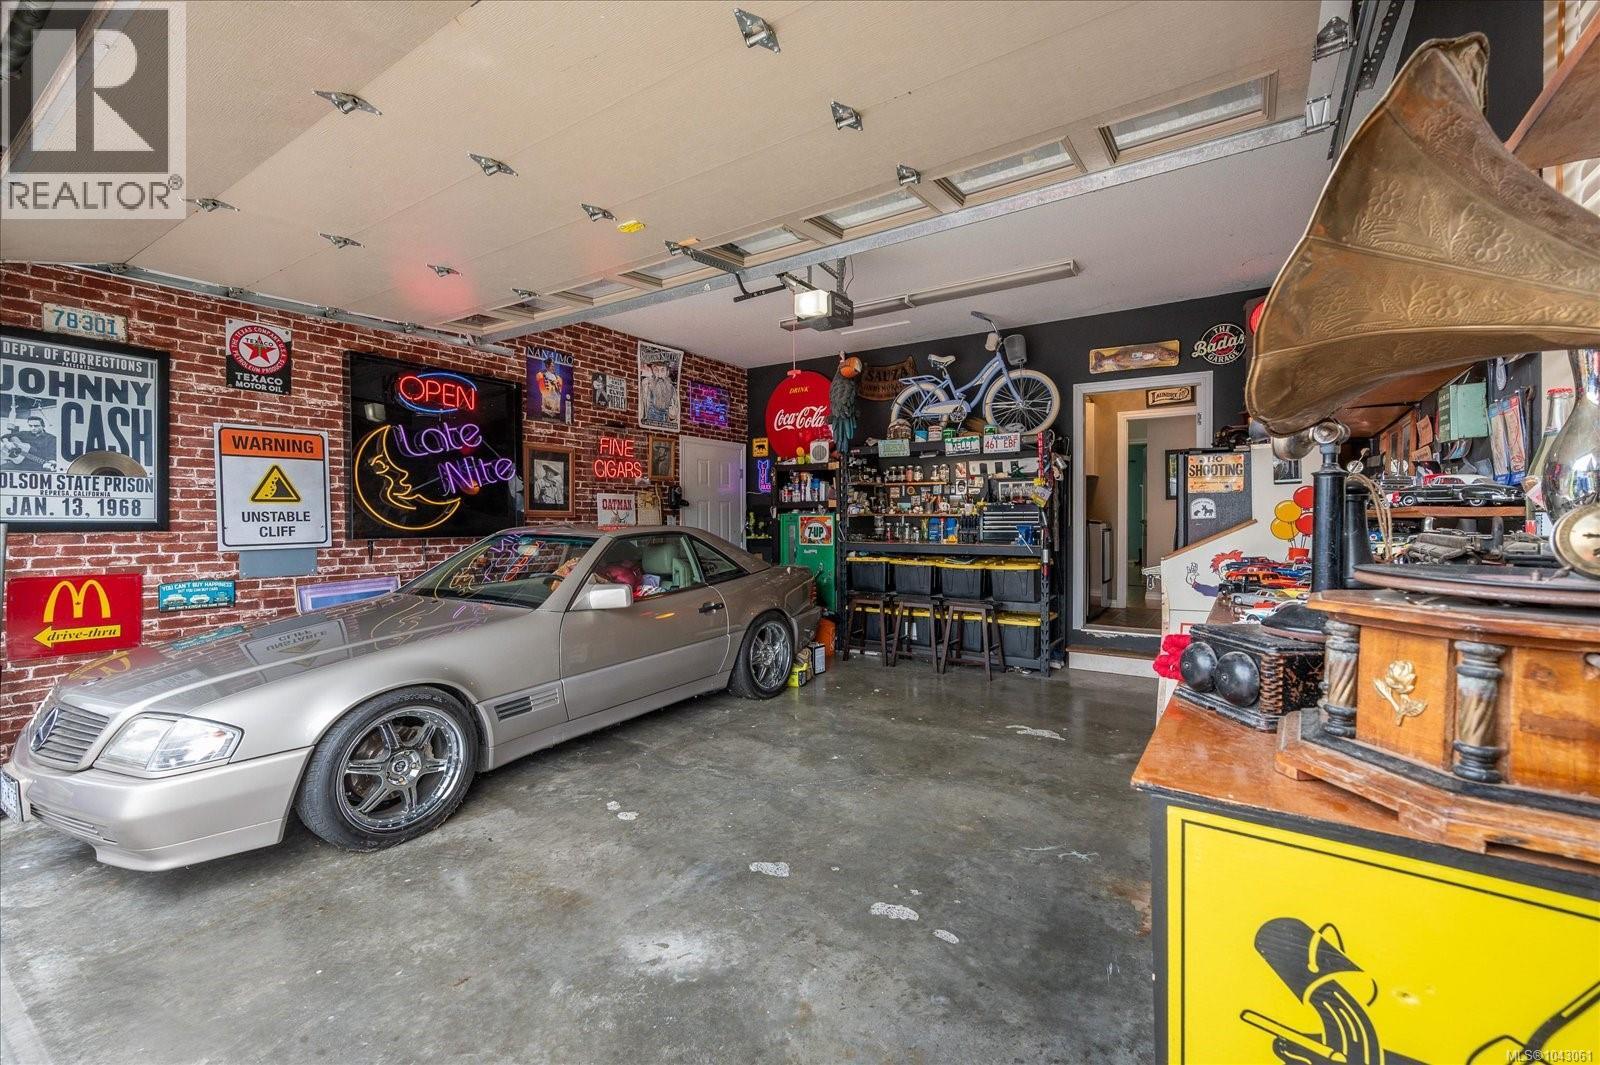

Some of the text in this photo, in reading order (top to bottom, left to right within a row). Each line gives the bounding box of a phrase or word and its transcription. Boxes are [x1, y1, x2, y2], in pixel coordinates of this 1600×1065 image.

[53, 309, 119, 336] 78301
[1213, 326, 1231, 334] THE
[254, 327, 278, 341] COMPANY
[244, 338, 274, 347] TEXACO
[2, 341, 143, 373] DEPT. OF CORRECTIONS
[231, 350, 261, 373] PETROLEUM
[527, 346, 574, 365] NANAIMO
[1207, 350, 1240, 363] GARAGE
[0, 363, 152, 406] JOHNNY
[235, 372, 283, 386] TEXACO
[235, 380, 283, 393] MOTOR OIL
[399, 375, 475, 411] OPEN
[789, 386, 809, 395] DRINK
[774, 405, 828, 431] Coca-Cola
[61, 401, 153, 467] CASH
[398, 422, 483, 457] Late
[232, 435, 314, 454] WARNING
[600, 437, 635, 457] FINE
[985, 438, 1019, 450] 461 EBF
[594, 459, 643, 478] CIGARS
[1189, 463, 1243, 477] SHOOTING
[57, 474, 100, 491] STATE
[104, 477, 153, 493] PRISON
[73, 490, 111, 498] CALIFORNIA
[6, 496, 142, 518] JAN. 13, 1968
[602, 498, 632, 511] OATMAN
[241, 510, 311, 523] UNSTABLE
[259, 526, 296, 538] CLIFF
[174, 582, 191, 590] CAN'T
[204, 580, 233, 588] HAPPINESS
[46, 627, 118, 643] drive-thru
